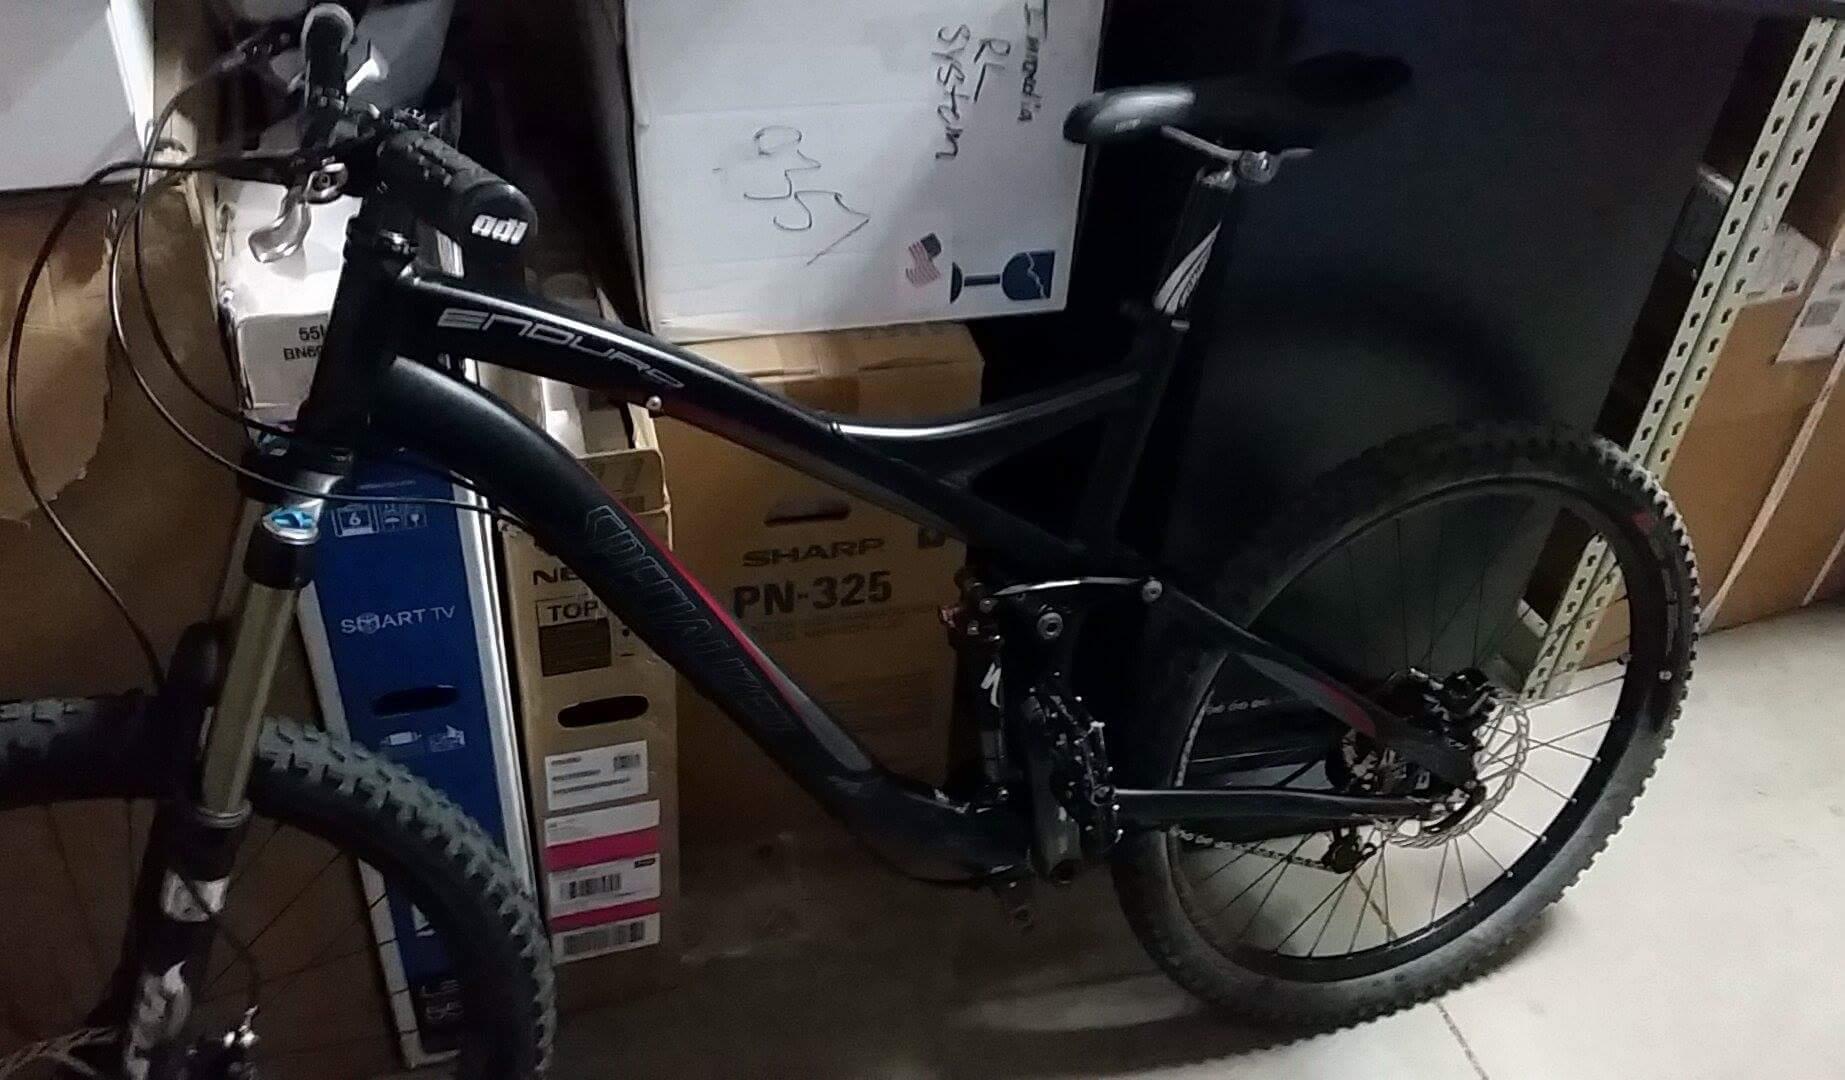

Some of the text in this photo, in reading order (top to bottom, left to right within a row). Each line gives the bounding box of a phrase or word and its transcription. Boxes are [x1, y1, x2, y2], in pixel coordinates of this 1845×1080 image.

[741, 537, 884, 567] SHARP
[732, 570, 892, 619] PN-325
[430, 605, 456, 621] TV
[546, 600, 599, 622] TOP
